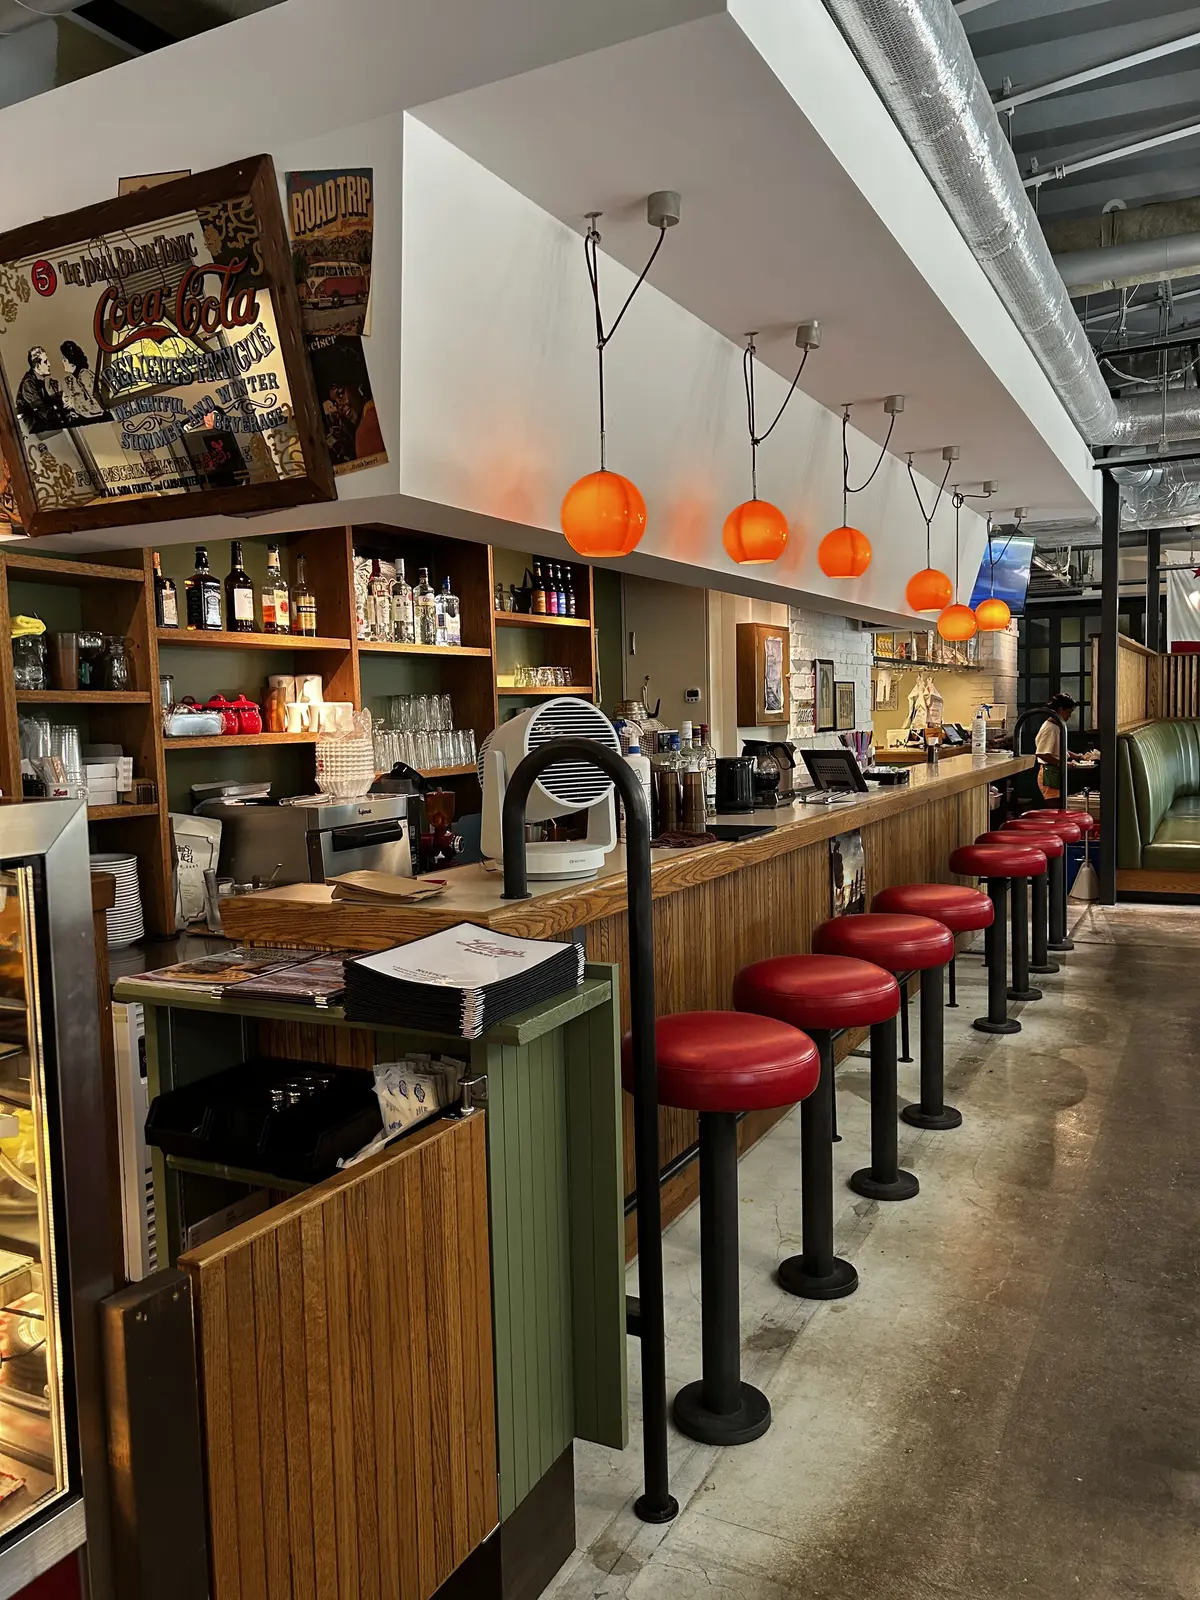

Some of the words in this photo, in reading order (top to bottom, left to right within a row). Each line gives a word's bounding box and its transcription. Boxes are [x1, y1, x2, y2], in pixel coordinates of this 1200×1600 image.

[292, 178, 338, 236] ROAD
[336, 175, 371, 218] TRIP
[58, 260, 85, 286] THE
[80, 251, 118, 287] IDEAL
[114, 244, 157, 279] BRAIN
[154, 232, 199, 268] TONIC
[102, 354, 195, 395] RELIEVES
[196, 322, 276, 383] FATIGUE
[308, 334, 337, 351] eiser
[114, 396, 187, 422] DELIGHTFUL
[121, 422, 186, 451] SUMMER
[186, 395, 216, 426] AND
[215, 372, 280, 404] WINTER
[213, 407, 288, 434] BEVERAGE
